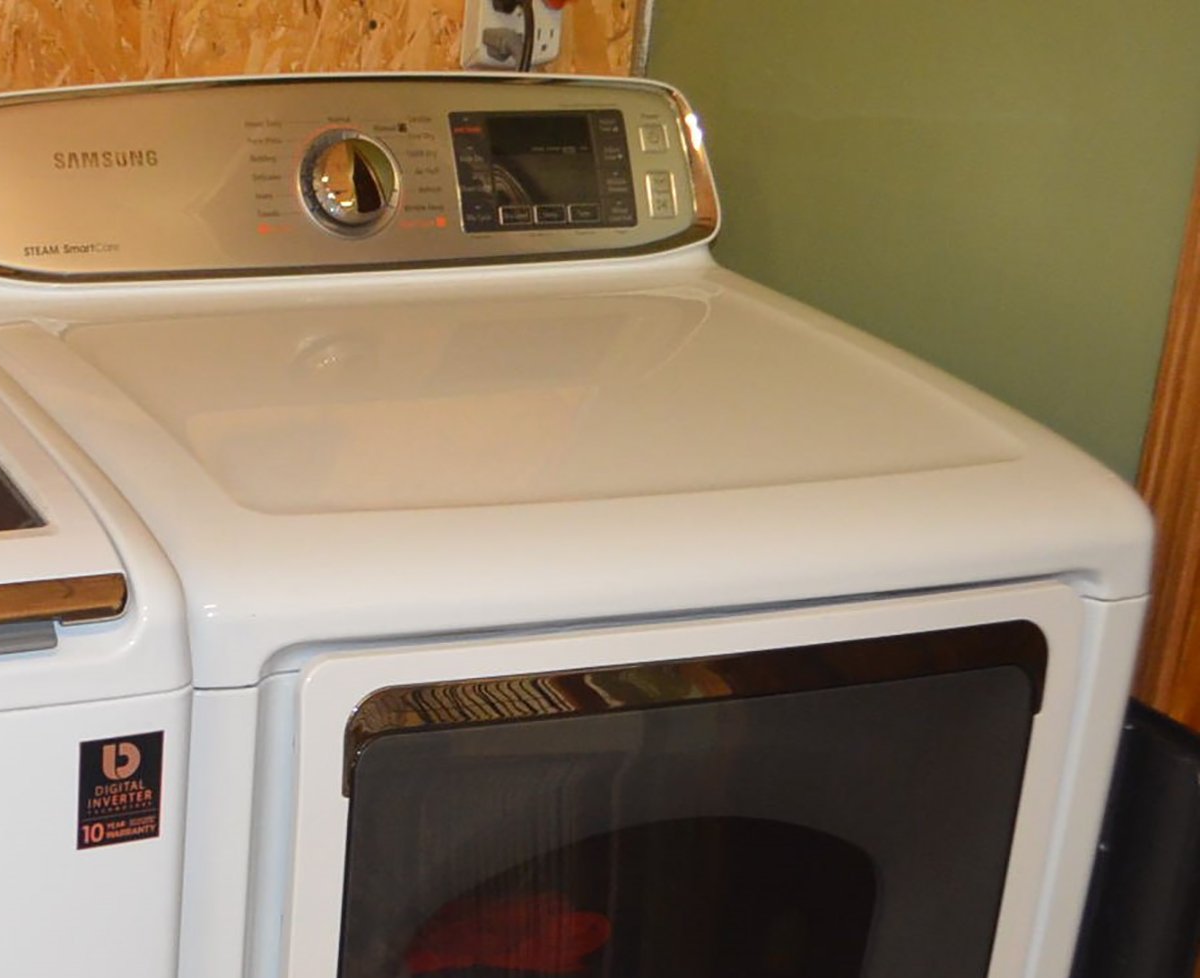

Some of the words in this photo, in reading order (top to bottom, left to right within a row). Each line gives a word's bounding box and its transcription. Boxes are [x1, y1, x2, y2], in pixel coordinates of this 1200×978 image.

[52, 149, 159, 170] SAMSUNG
[23, 244, 60, 257] STEAM
[62, 242, 120, 254] SmartCare
[95, 779, 144, 797] DIGITAL
[88, 789, 152, 808] INVERTER
[82, 822, 105, 844] 10
[106, 820, 126, 829] YEAR
[106, 824, 157, 839] WARRANTY
